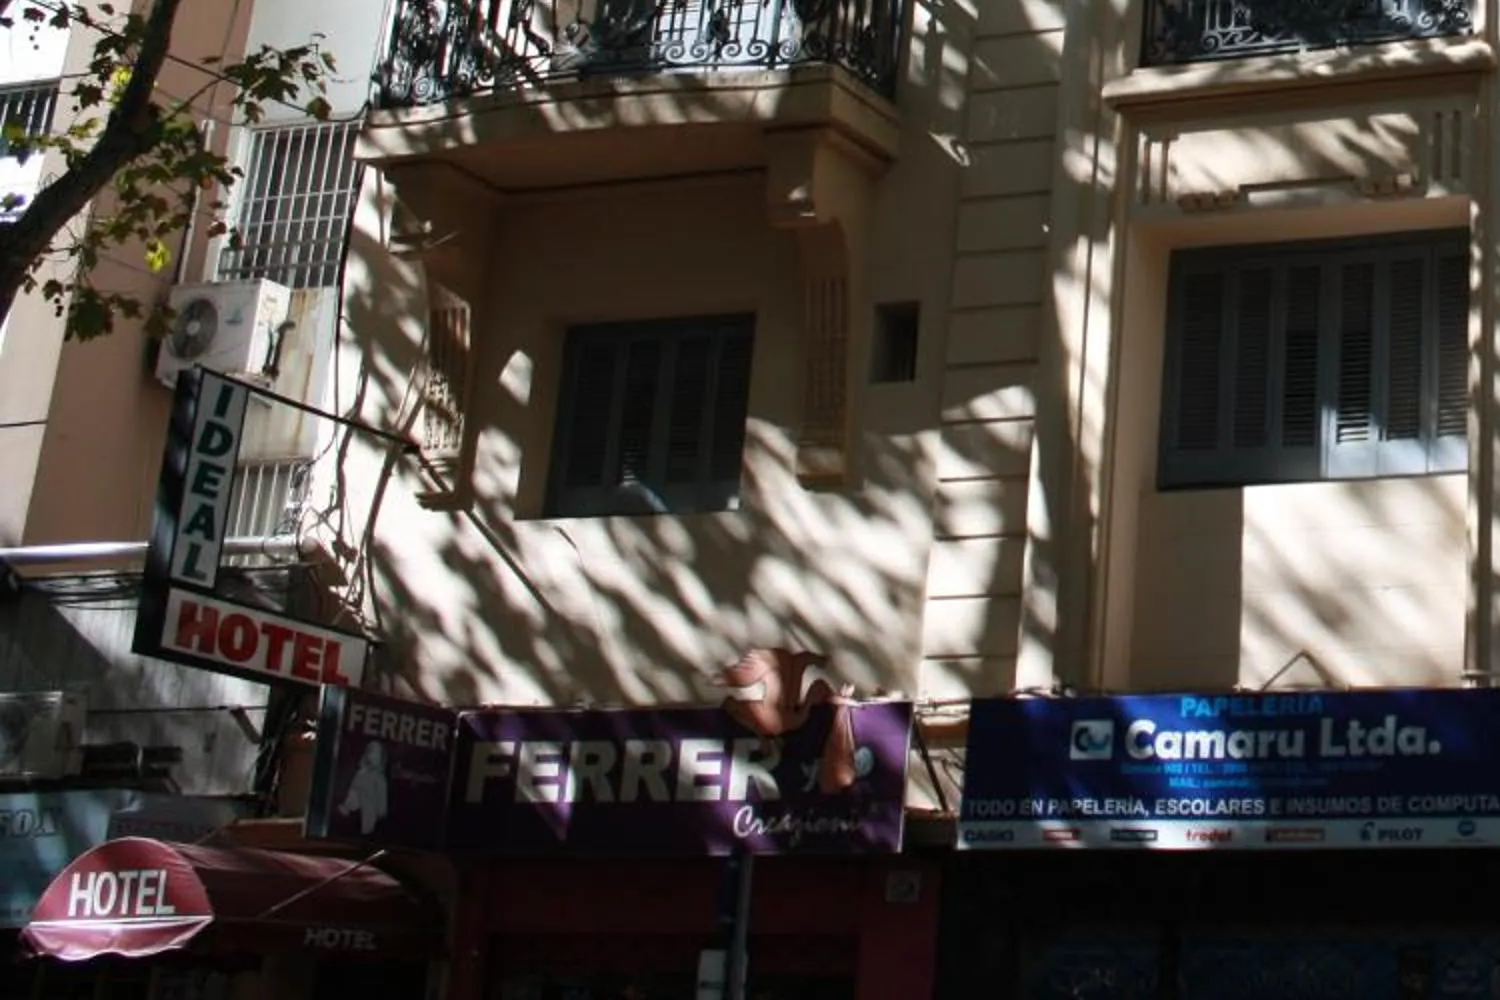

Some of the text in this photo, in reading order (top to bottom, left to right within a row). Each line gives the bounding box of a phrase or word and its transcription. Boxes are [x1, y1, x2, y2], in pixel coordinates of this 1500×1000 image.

[185, 383, 233, 582] IDEAL
[176, 602, 349, 686] HOTEL
[347, 703, 449, 751] FERRER
[1124, 713, 1443, 760] Camaru Ltda.
[465, 737, 783, 804] FERRER
[969, 800, 1014, 816] TODO
[1019, 799, 1045, 815] EN
[1048, 795, 1149, 817] PAPELERÍA,
[1155, 798, 1264, 815] ESCOLARES
[1269, 797, 1283, 814] E
[1287, 796, 1372, 814] INSUMOS
[1377, 796, 1403, 811] DE
[1378, 827, 1423, 841] PILOT
[68, 869, 175, 916] HOTEL
[303, 926, 378, 950] HOTEL
